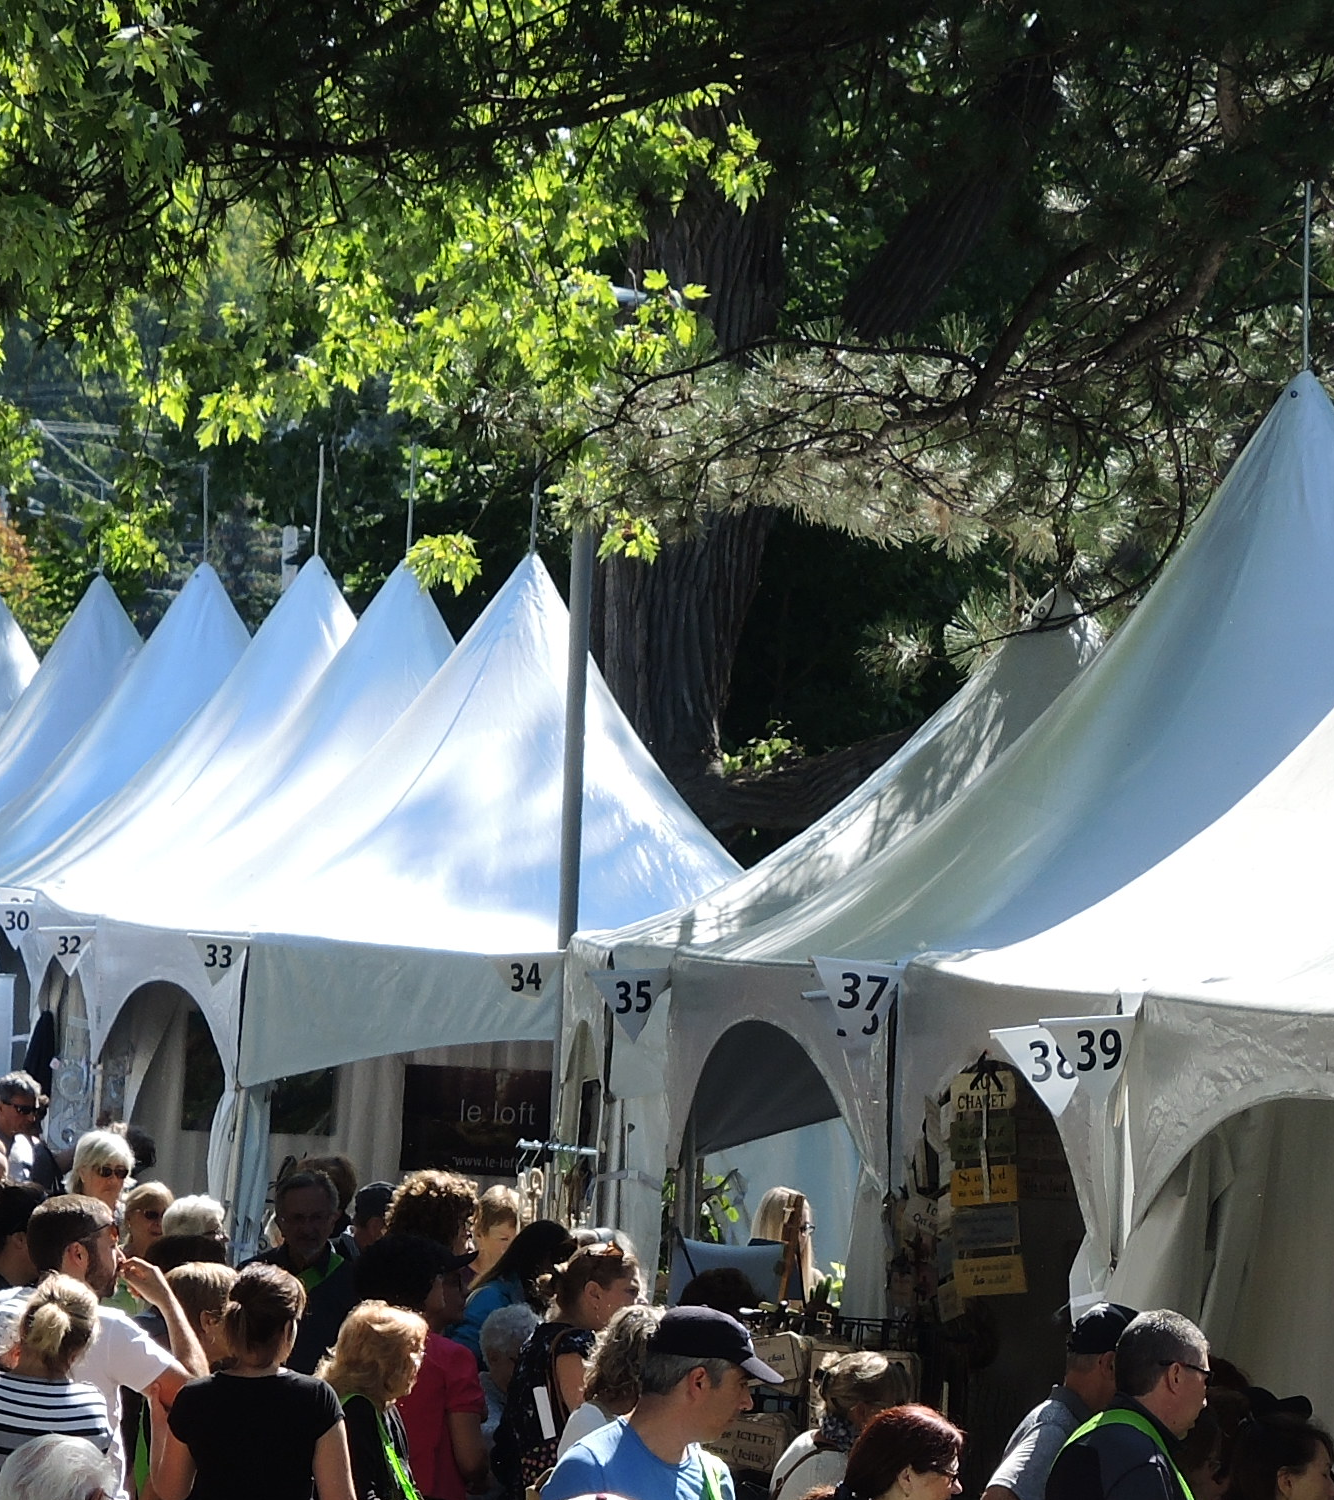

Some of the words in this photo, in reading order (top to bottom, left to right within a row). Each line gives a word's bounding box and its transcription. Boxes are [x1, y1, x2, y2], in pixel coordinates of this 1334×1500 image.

[5, 910, 30, 931] 30
[57, 935, 81, 956] 32
[204, 943, 232, 968] 33
[510, 962, 542, 992] 34
[615, 979, 652, 1014] 35
[837, 972, 889, 1011] 37
[1076, 1029, 1122, 1071] 39
[461, 1099, 482, 1122] le
[494, 1101, 535, 1126] loft
[957, 1093, 1006, 1110] CHAET
